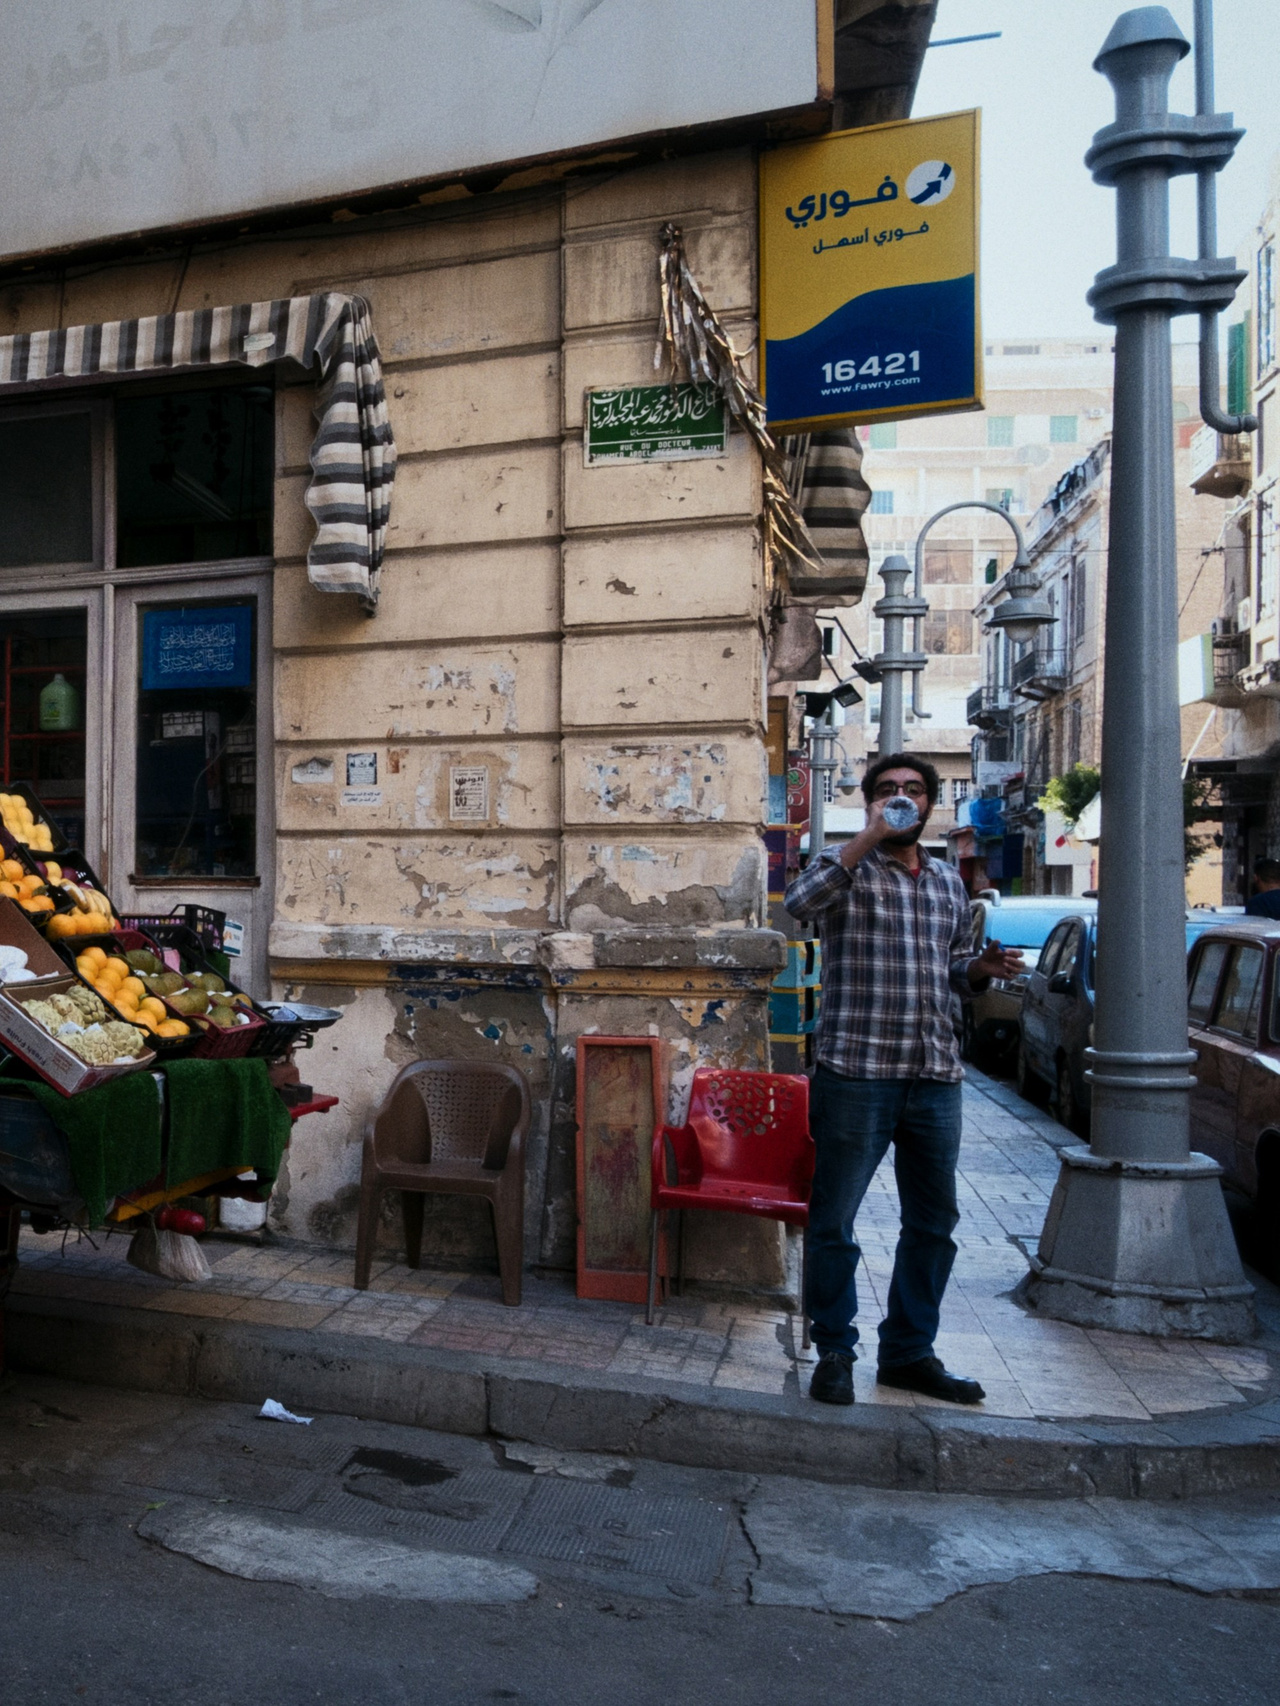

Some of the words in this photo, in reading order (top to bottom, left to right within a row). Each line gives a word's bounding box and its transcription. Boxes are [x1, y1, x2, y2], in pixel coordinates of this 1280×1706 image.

[785, 175, 898, 229] فوري
[873, 221, 929, 246] فوري
[820, 349, 921, 384] 16421
[820, 375, 921, 397] www.fawry.com
[619, 444, 635, 452] RUE
[641, 442, 652, 450] DU
[657, 440, 692, 449] DOCTEUR
